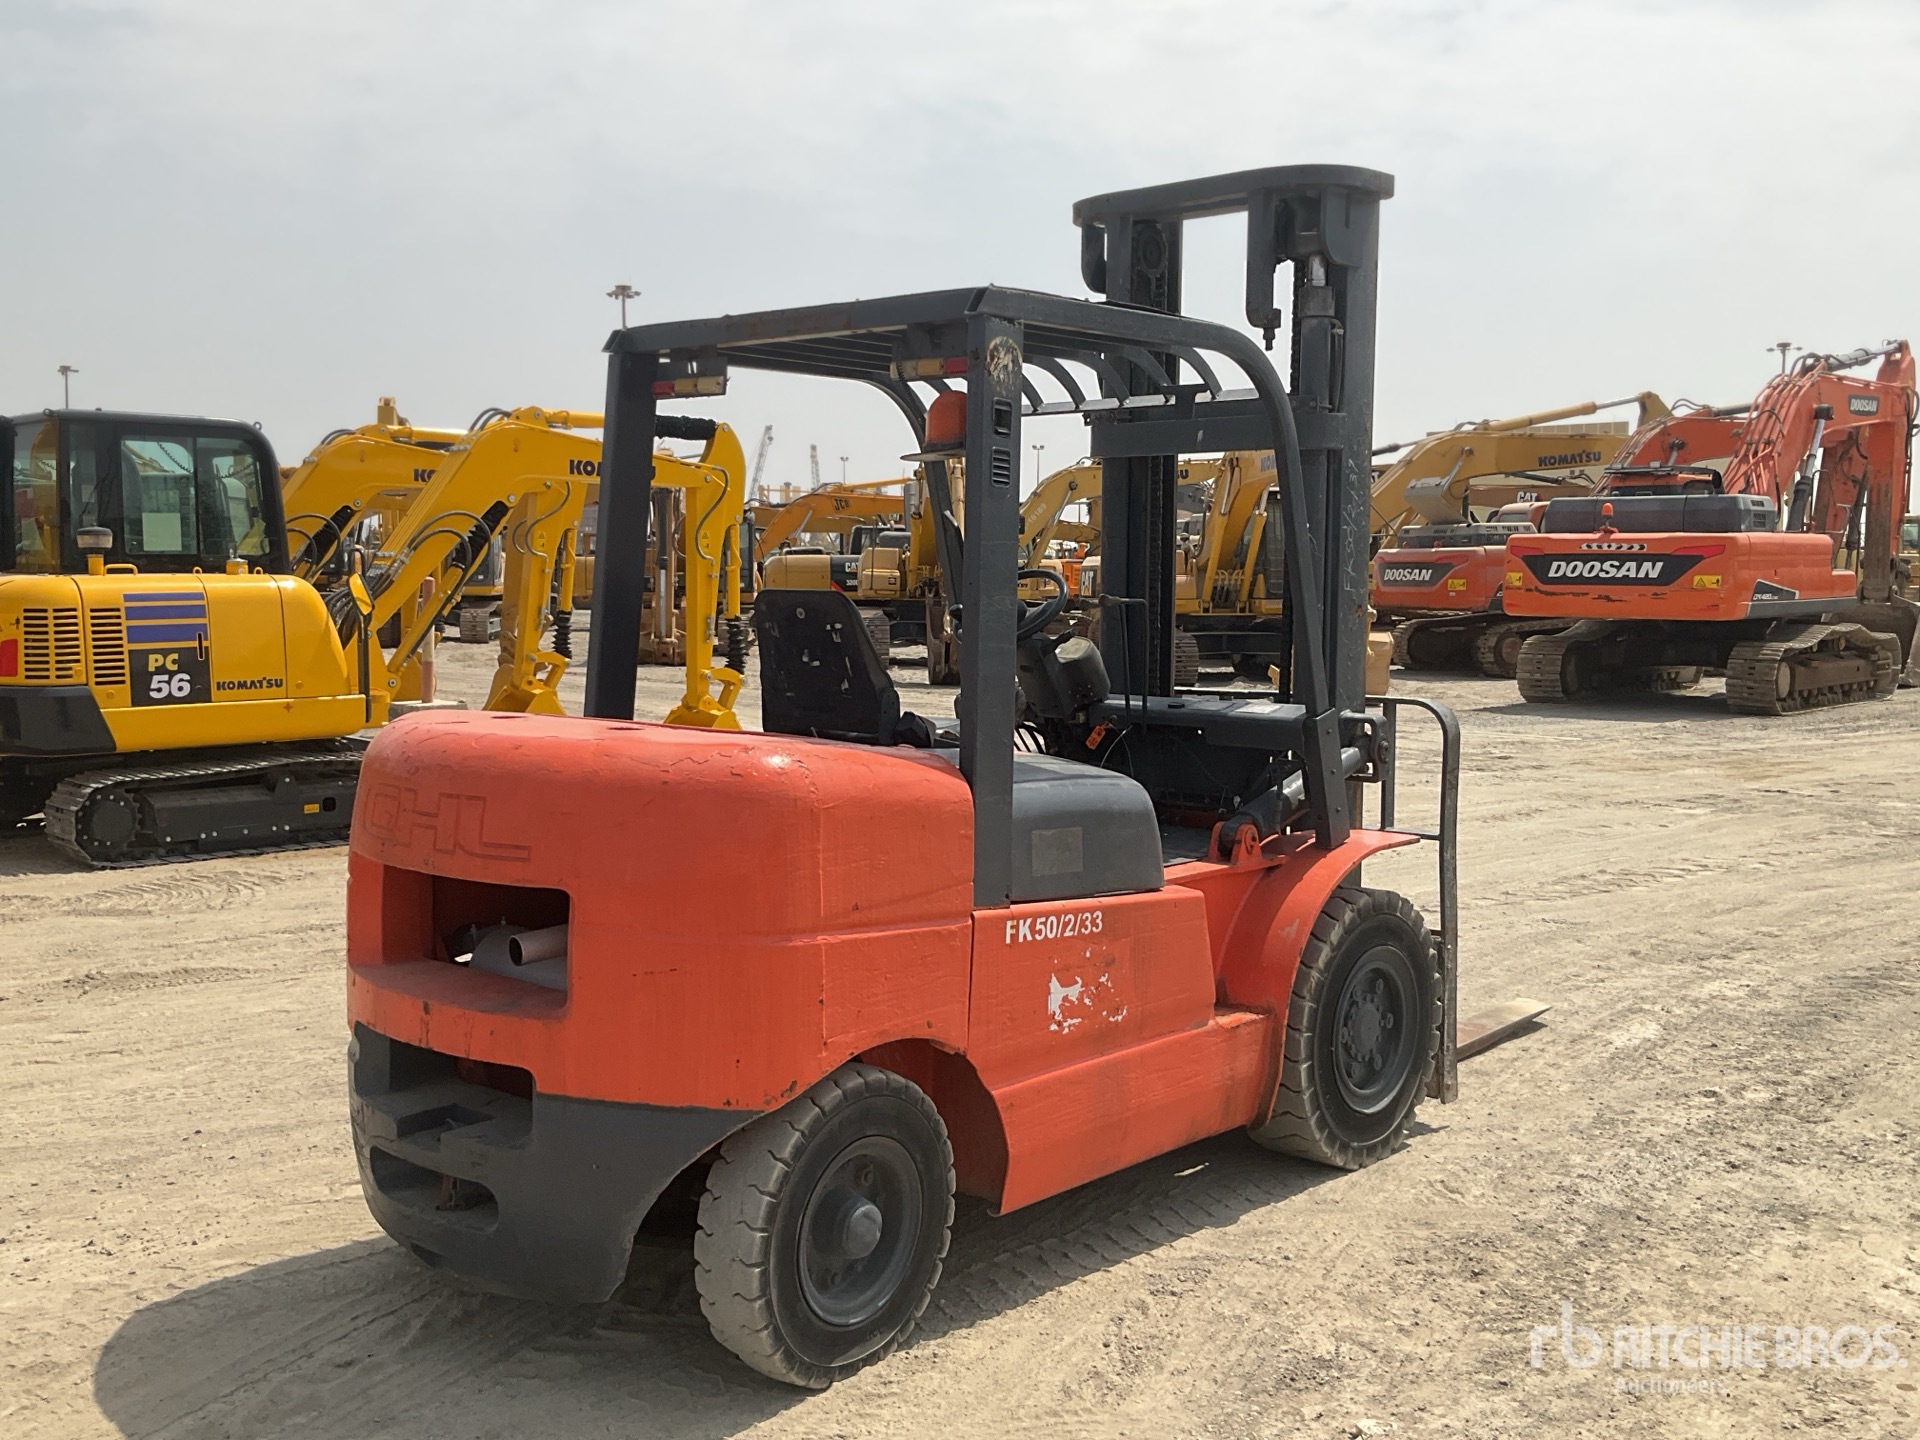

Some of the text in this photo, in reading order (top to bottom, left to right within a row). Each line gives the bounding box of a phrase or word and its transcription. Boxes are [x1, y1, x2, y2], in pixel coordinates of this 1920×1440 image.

[1850, 398, 1878, 412] DOOSAN
[1538, 449, 1602, 468] KOMATSU
[1517, 491, 1538, 503] CAT
[1384, 568, 1433, 581] DOOSAN
[1548, 560, 1664, 579] DOOSAN
[148, 653, 179, 671] PC
[149, 673, 191, 699] 56
[216, 677, 283, 691] KOMATSU
[1005, 911, 1103, 944] FK50/2/33
